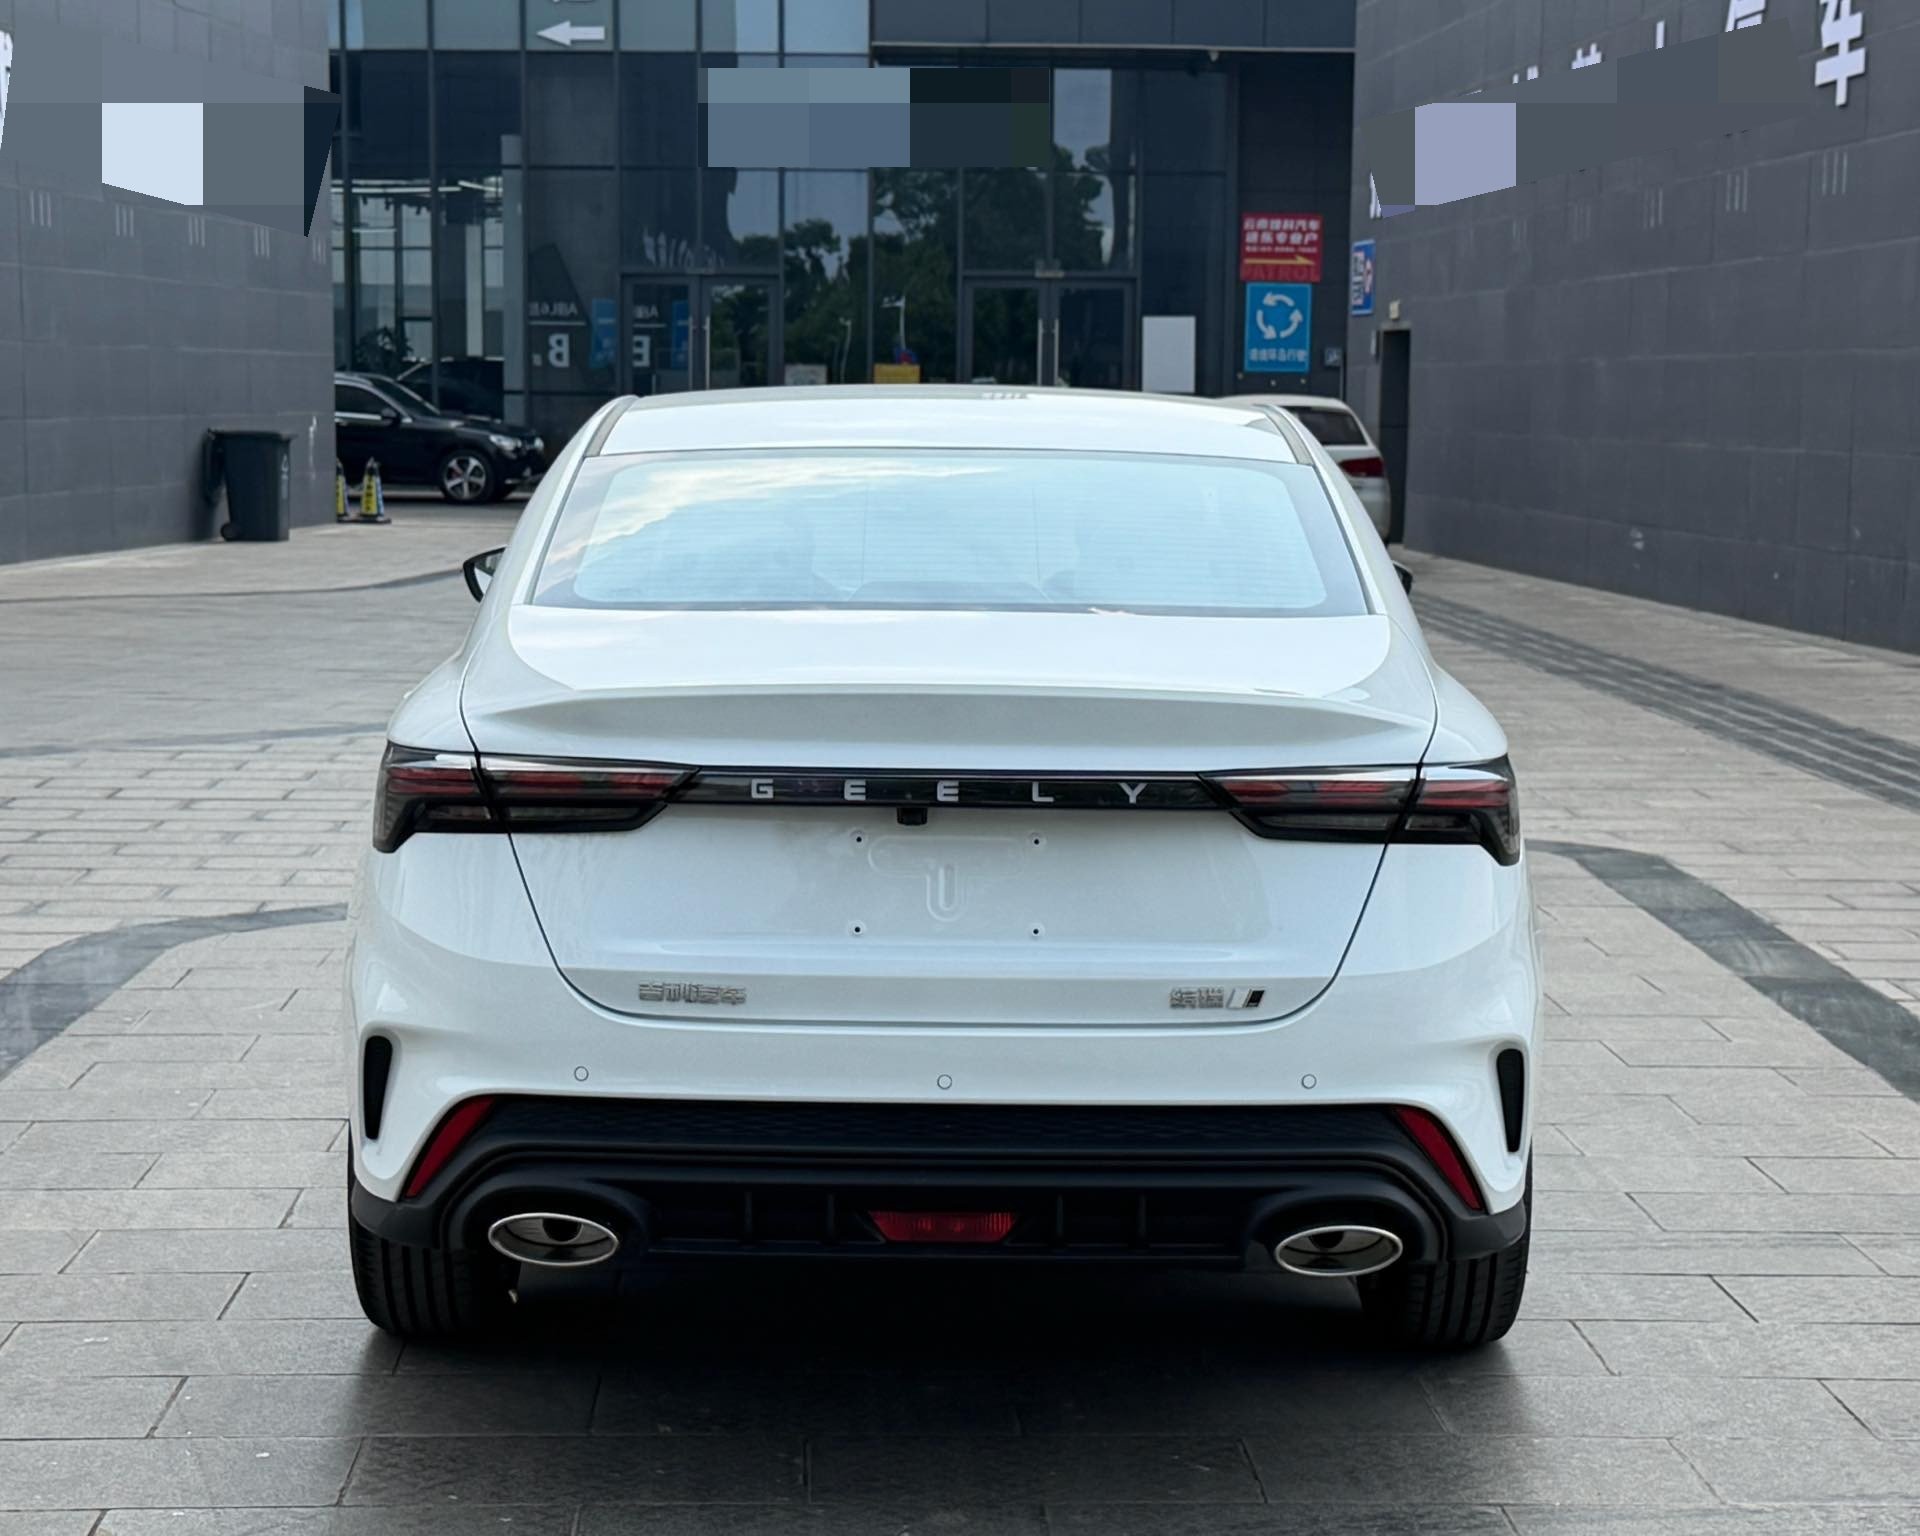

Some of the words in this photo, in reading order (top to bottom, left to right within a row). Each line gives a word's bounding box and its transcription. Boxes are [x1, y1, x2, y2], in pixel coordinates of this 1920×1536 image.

[750, 777, 1148, 804] GEELY
[638, 982, 746, 1005] 吉利汽车
